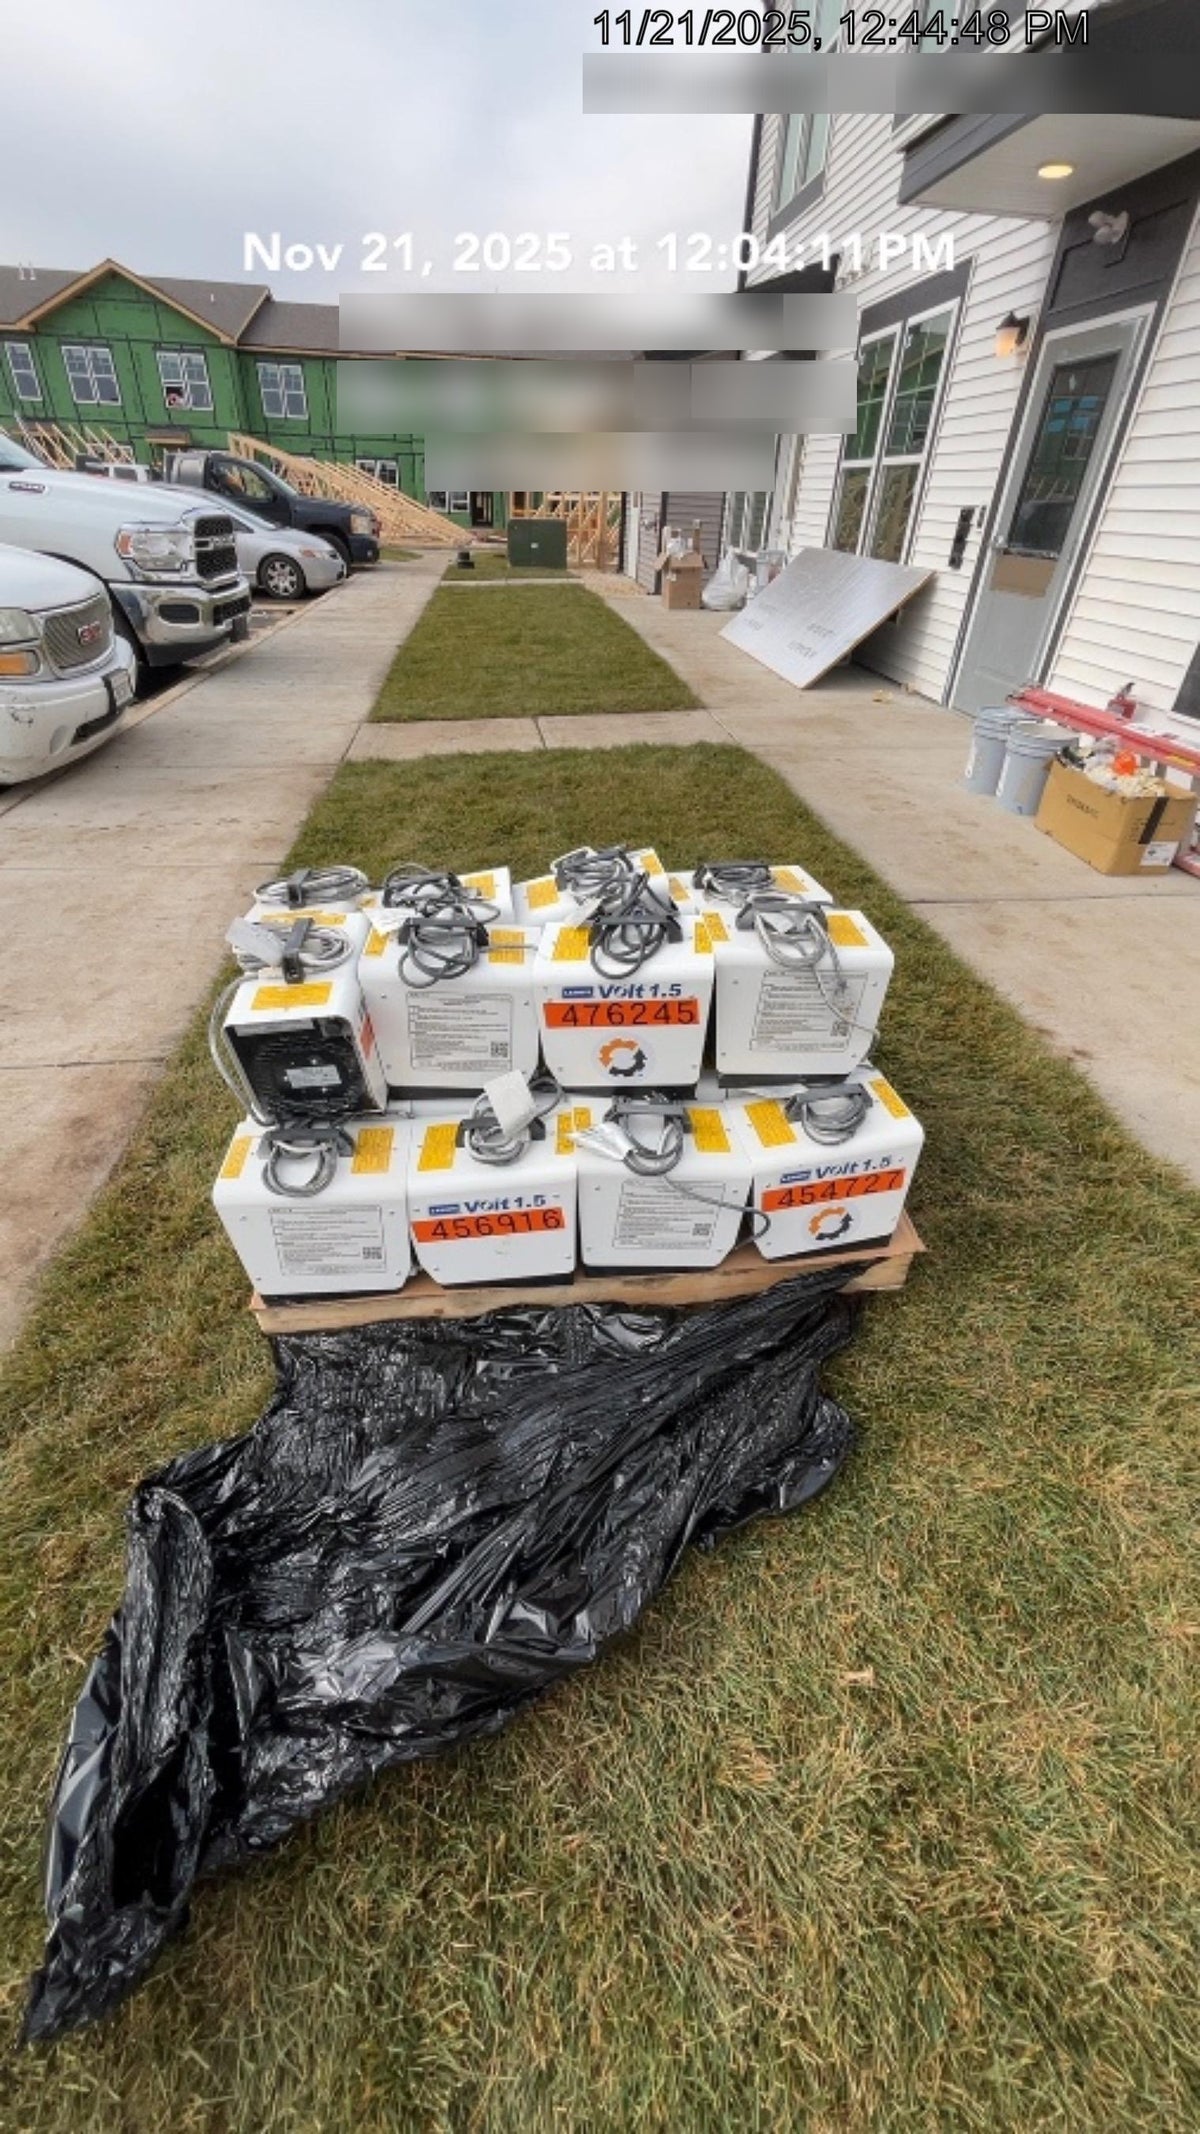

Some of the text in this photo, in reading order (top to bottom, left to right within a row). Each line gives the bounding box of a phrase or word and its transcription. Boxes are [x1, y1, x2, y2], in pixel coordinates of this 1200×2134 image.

[649, 983, 682, 998] 1.5
[562, 1001, 695, 1027] 476245
[777, 1172, 901, 1207] 454727
[431, 1208, 561, 1240] 456916
